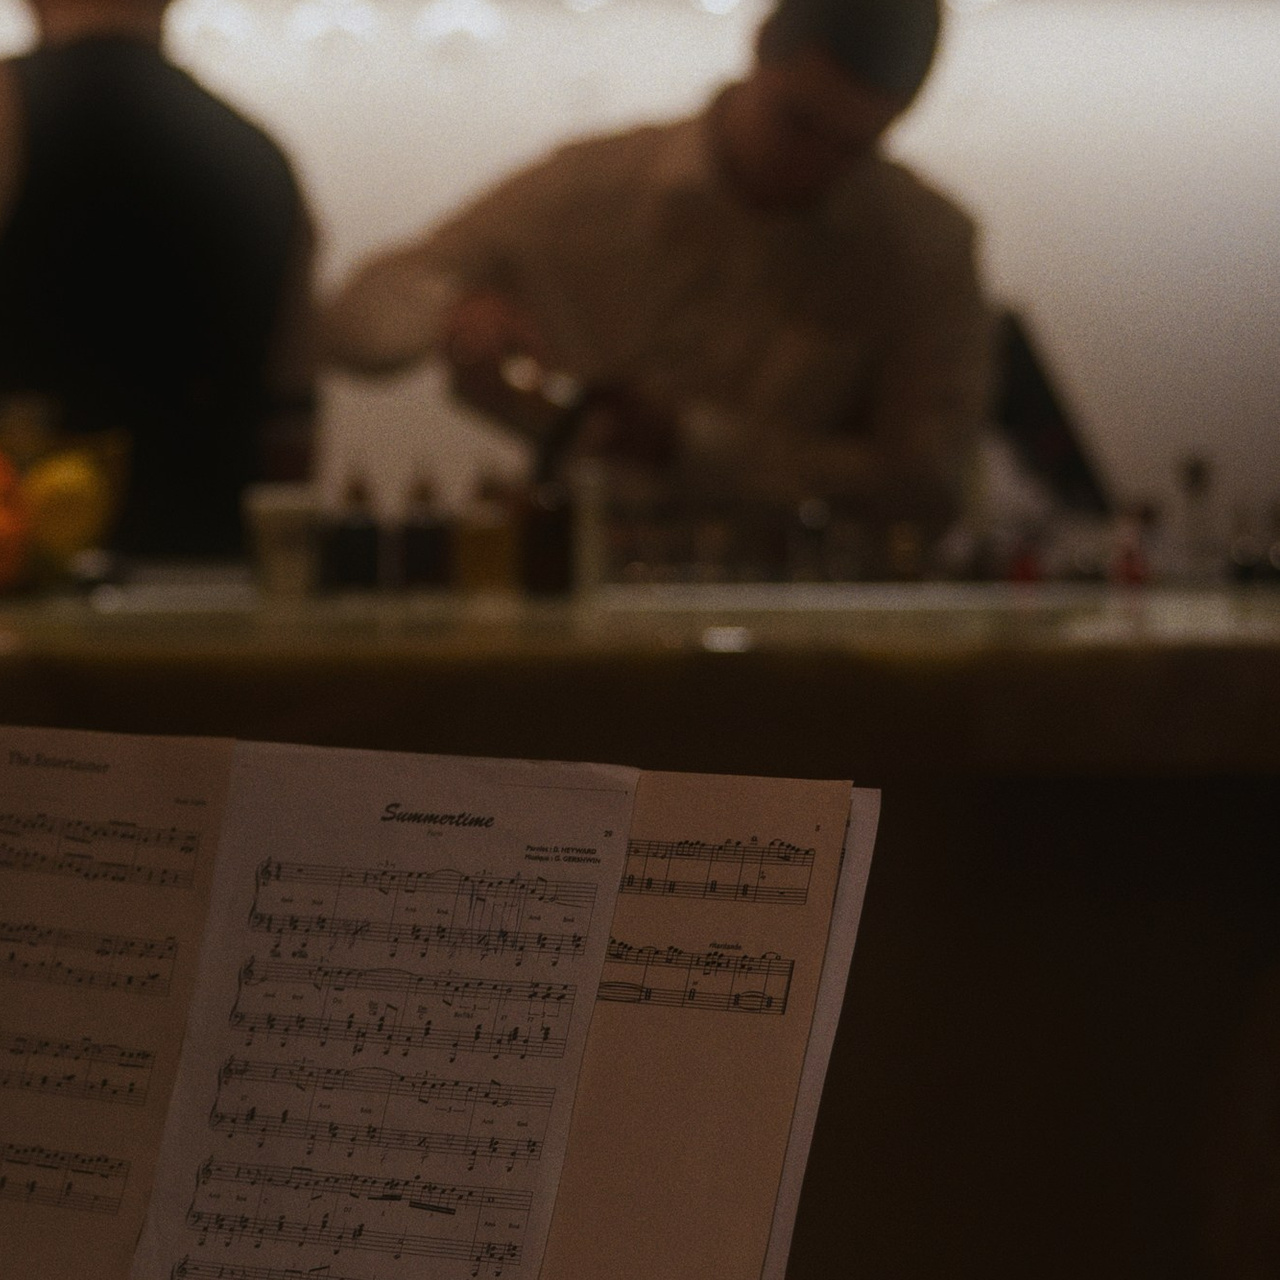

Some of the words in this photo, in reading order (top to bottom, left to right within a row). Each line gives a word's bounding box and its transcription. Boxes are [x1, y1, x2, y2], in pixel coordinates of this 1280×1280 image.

[9, 750, 31, 767] The
[34, 753, 110, 774] Entertainer
[380, 802, 495, 829] Summertime
[603, 830, 614, 838] 29
[561, 847, 597, 856] HEYWARD
[562, 856, 601, 864] GERSHWIN
